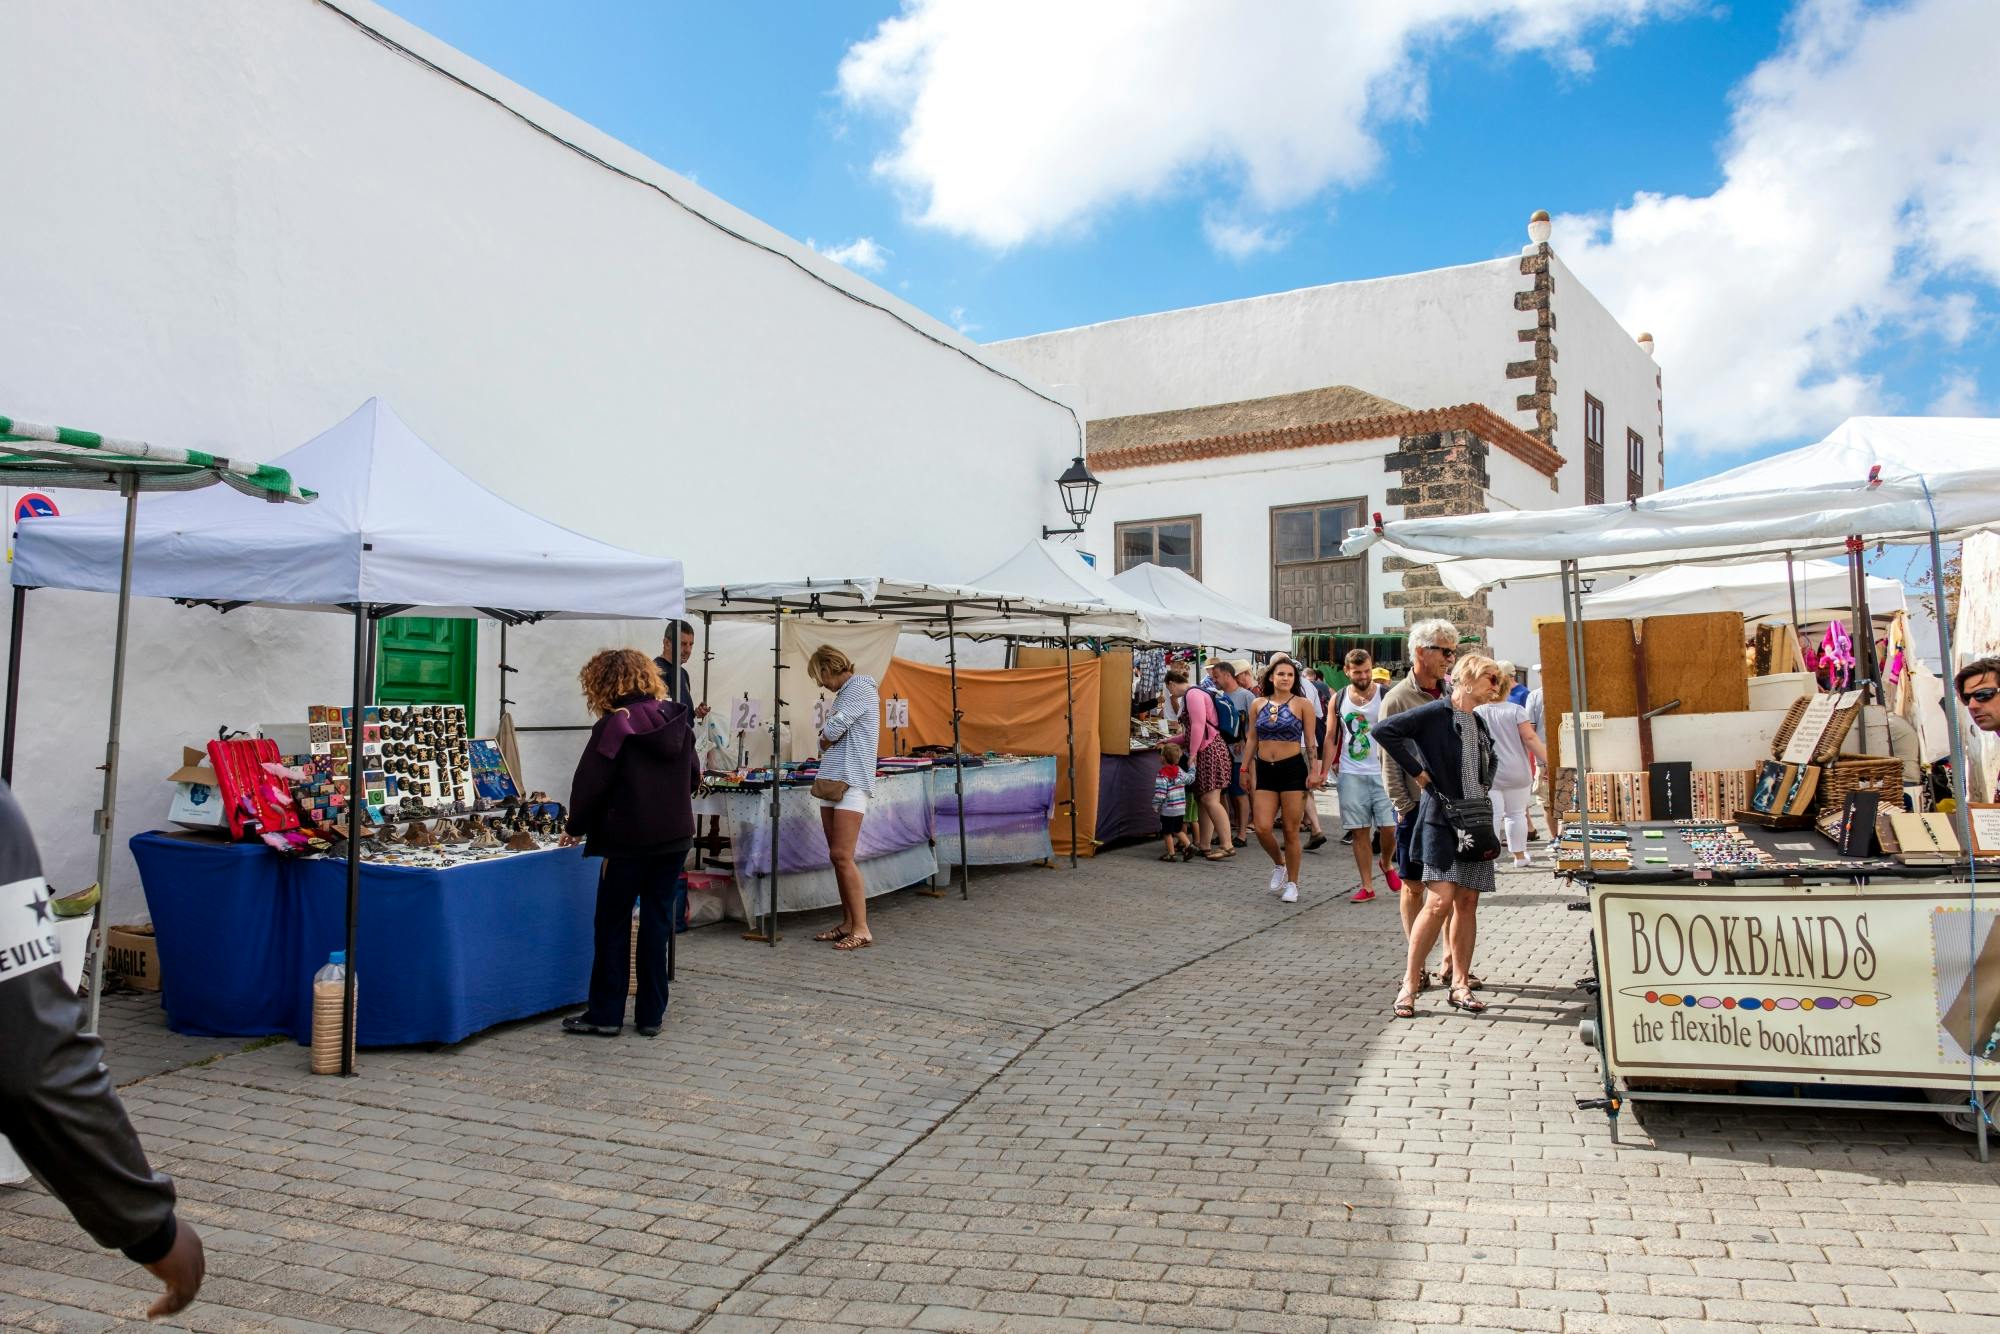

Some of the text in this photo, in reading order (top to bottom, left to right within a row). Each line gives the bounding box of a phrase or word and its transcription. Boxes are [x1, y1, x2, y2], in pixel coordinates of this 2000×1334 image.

[737, 703, 756, 729] 2€
[889, 703, 904, 725] 4€
[108, 946, 146, 977] FRAGILE
[1628, 911, 1877, 981] BOOKBANDS
[1632, 1011, 1882, 1057] the flexible bookmarks
